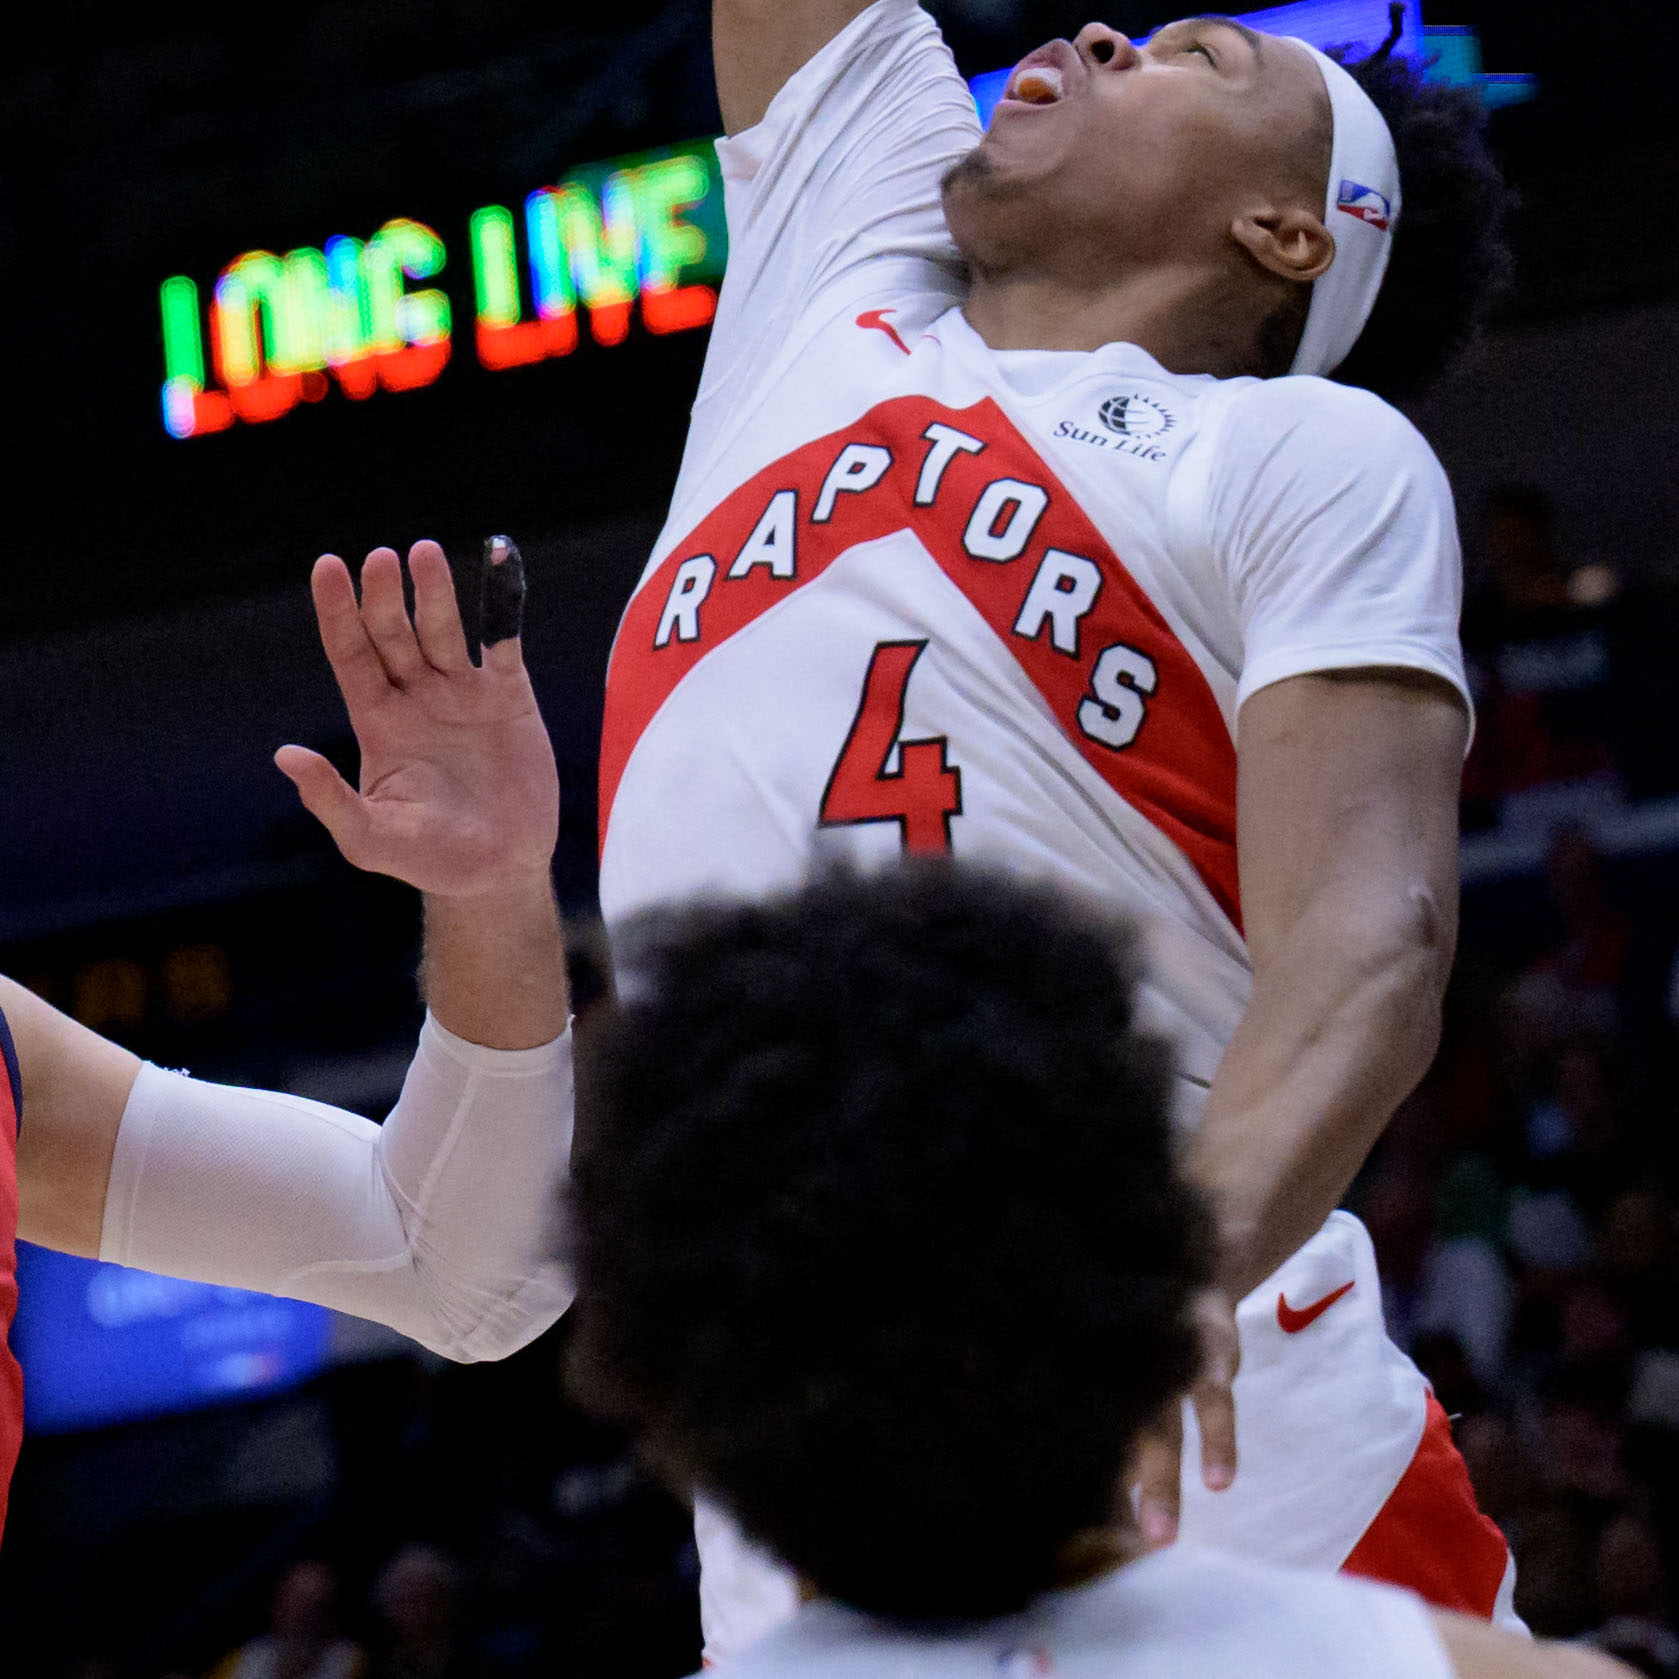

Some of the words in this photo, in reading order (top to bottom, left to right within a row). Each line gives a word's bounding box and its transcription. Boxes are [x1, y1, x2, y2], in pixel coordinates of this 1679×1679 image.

[158, 218, 454, 439] LONG
[469, 154, 722, 372] LIVE
[1053, 420, 1108, 447] Sun
[1114, 438, 1167, 462] Life
[652, 422, 1160, 751] RAPTORS
[818, 638, 965, 865] 4
